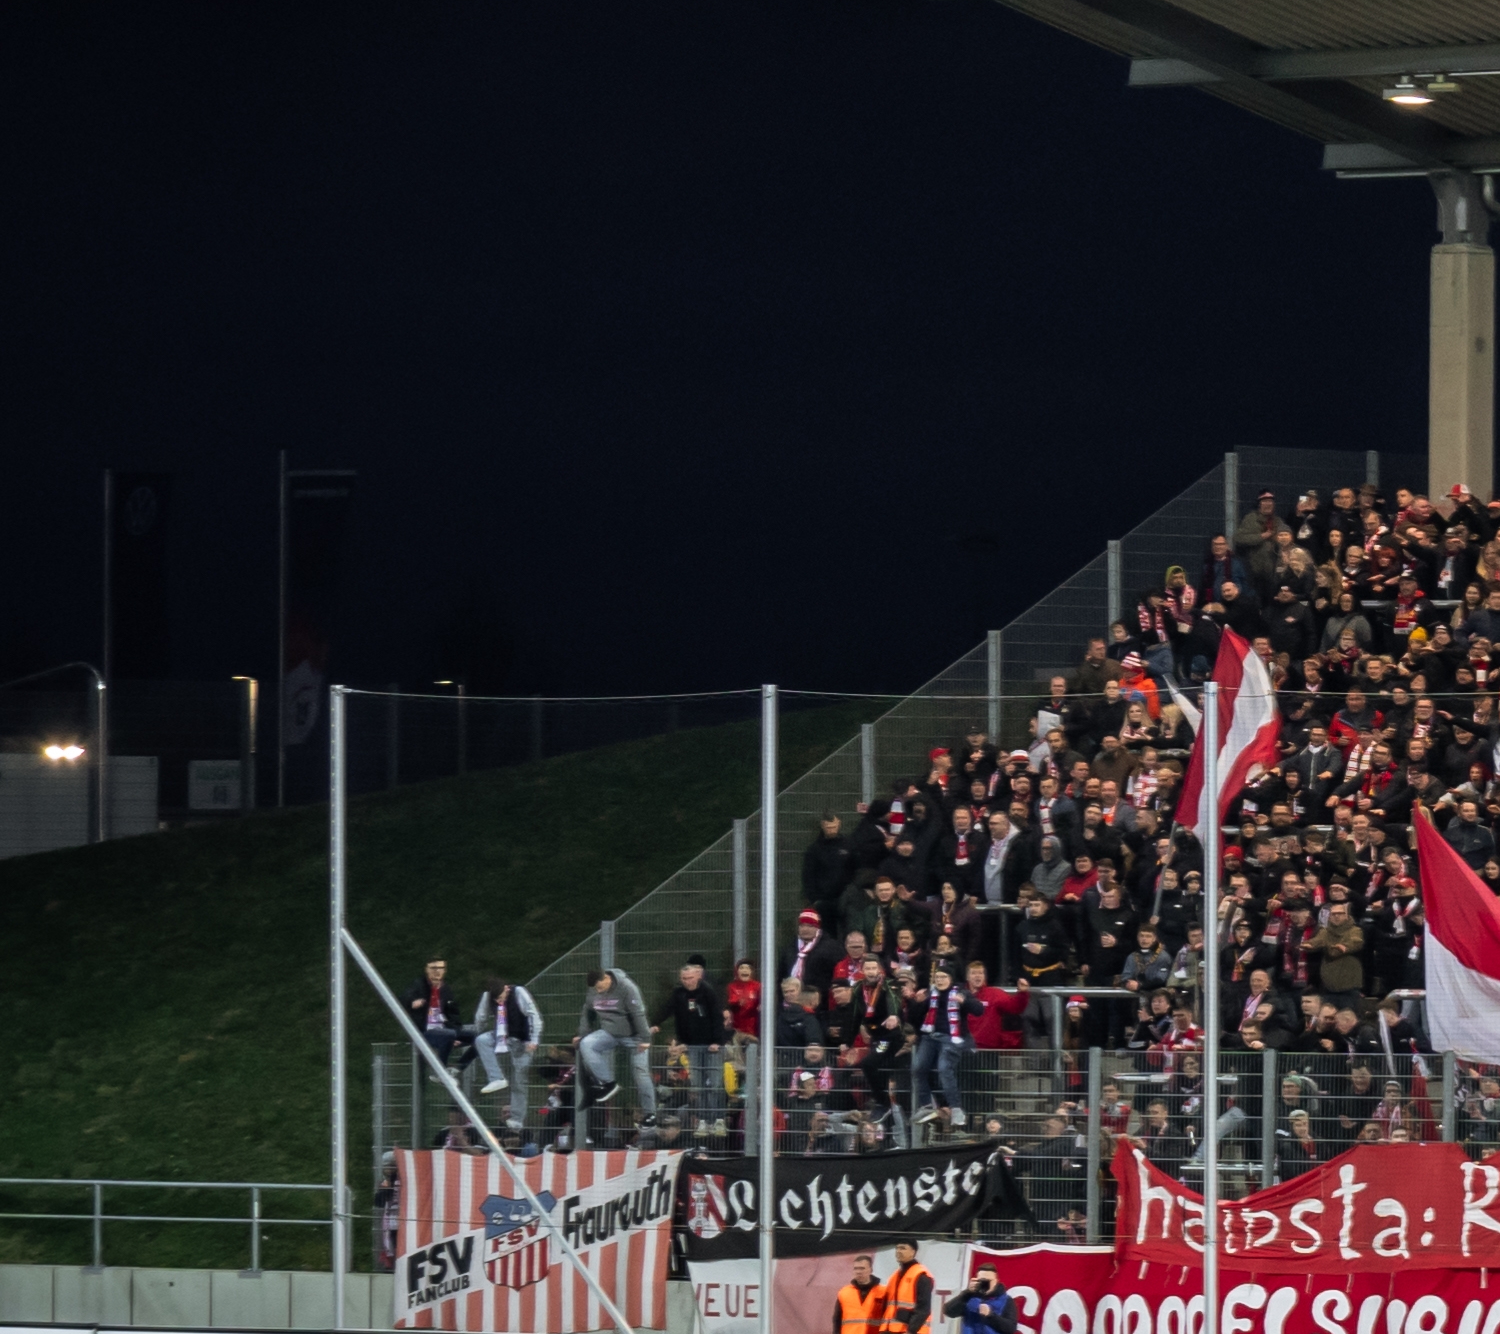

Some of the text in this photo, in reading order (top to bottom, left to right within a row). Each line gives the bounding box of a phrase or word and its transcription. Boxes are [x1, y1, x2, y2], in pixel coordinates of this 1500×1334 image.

[490, 1217, 541, 1254] FSV
[406, 1235, 475, 1295] FSV
[407, 1273, 471, 1310] FANCLUB
